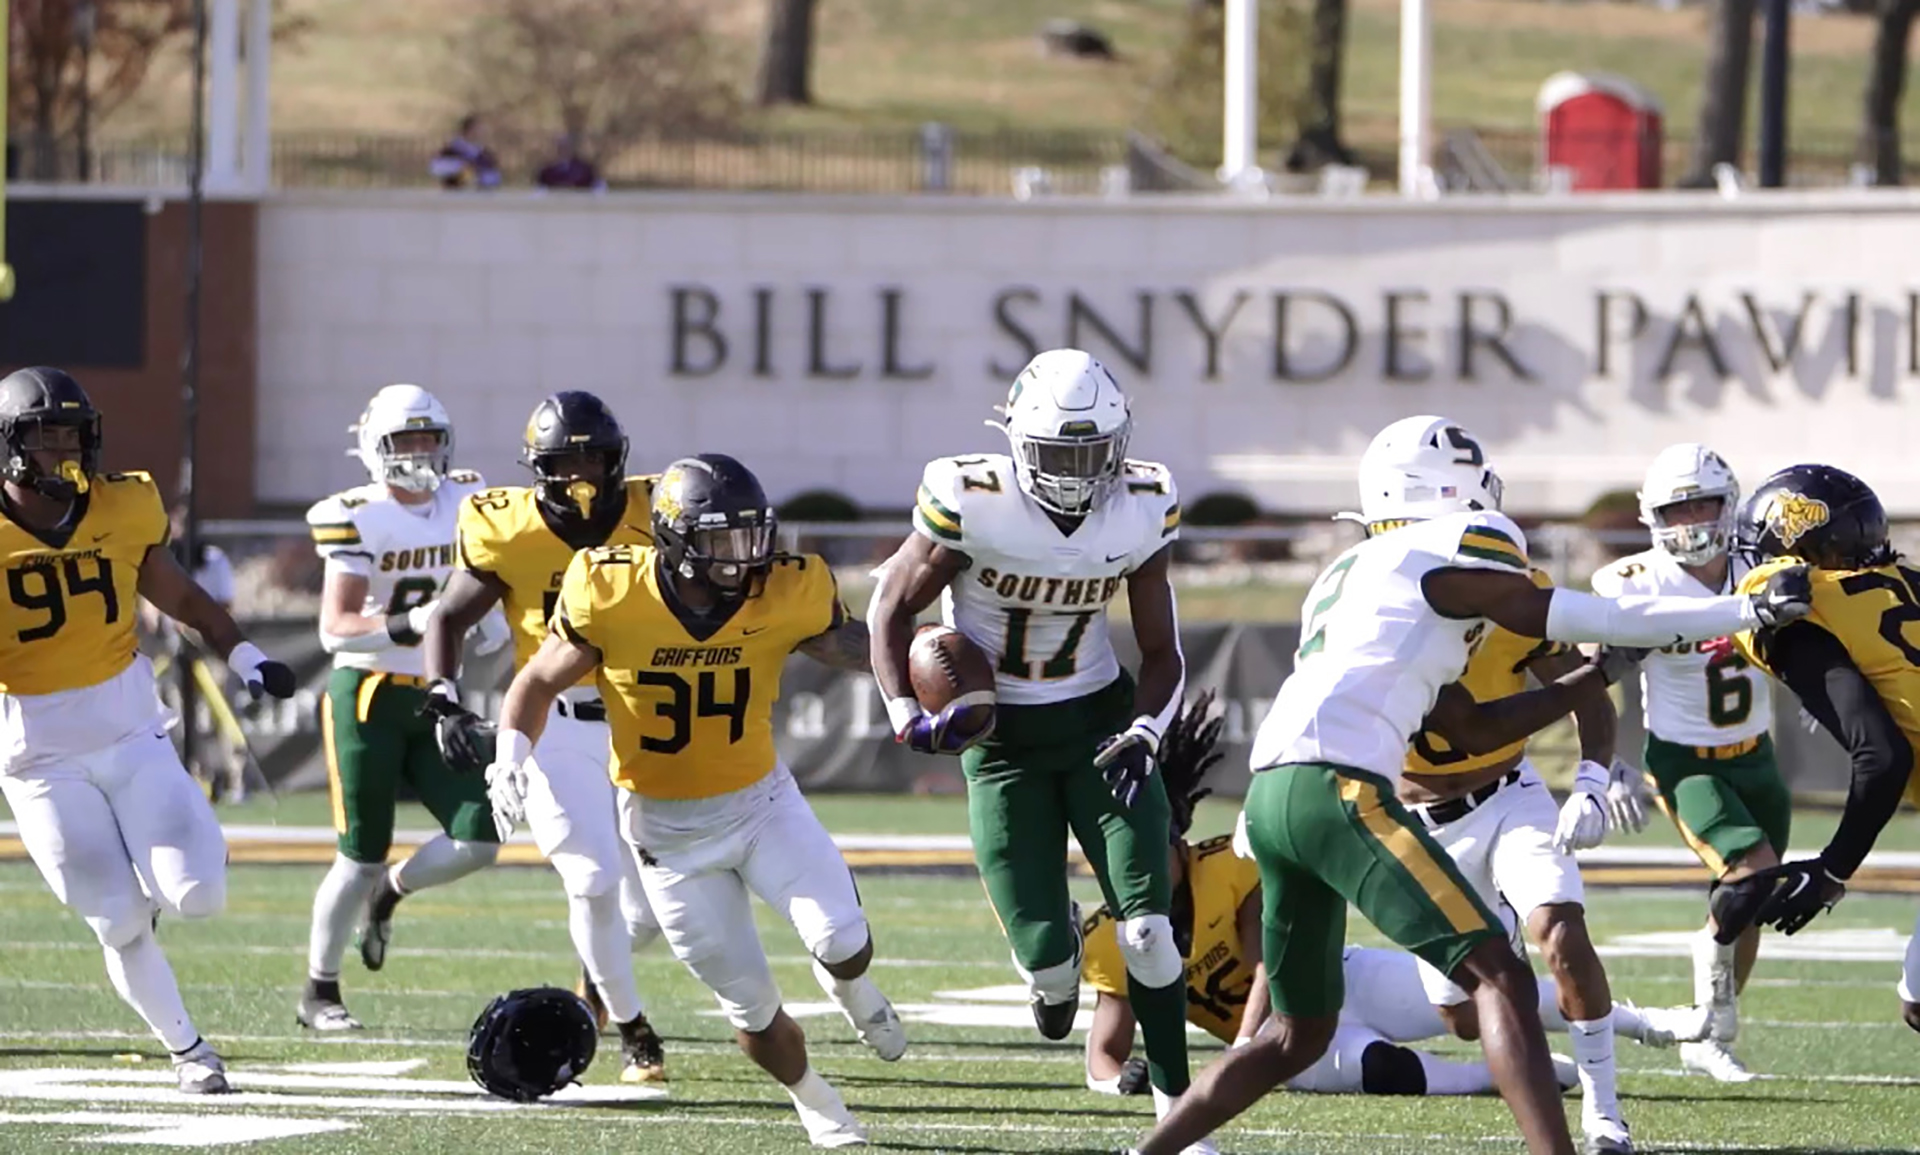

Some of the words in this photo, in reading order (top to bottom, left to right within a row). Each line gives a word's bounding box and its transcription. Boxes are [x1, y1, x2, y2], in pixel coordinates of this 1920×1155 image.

[667, 286, 934, 377] BILL
[987, 289, 1534, 382] SNYDER
[1595, 290, 1920, 378] PAVI
[6, 556, 120, 643] 94
[650, 646, 743, 668] GRIFFONS
[996, 606, 1102, 680] 17
[637, 666, 751, 755] 34
[1705, 653, 1753, 729] 6
